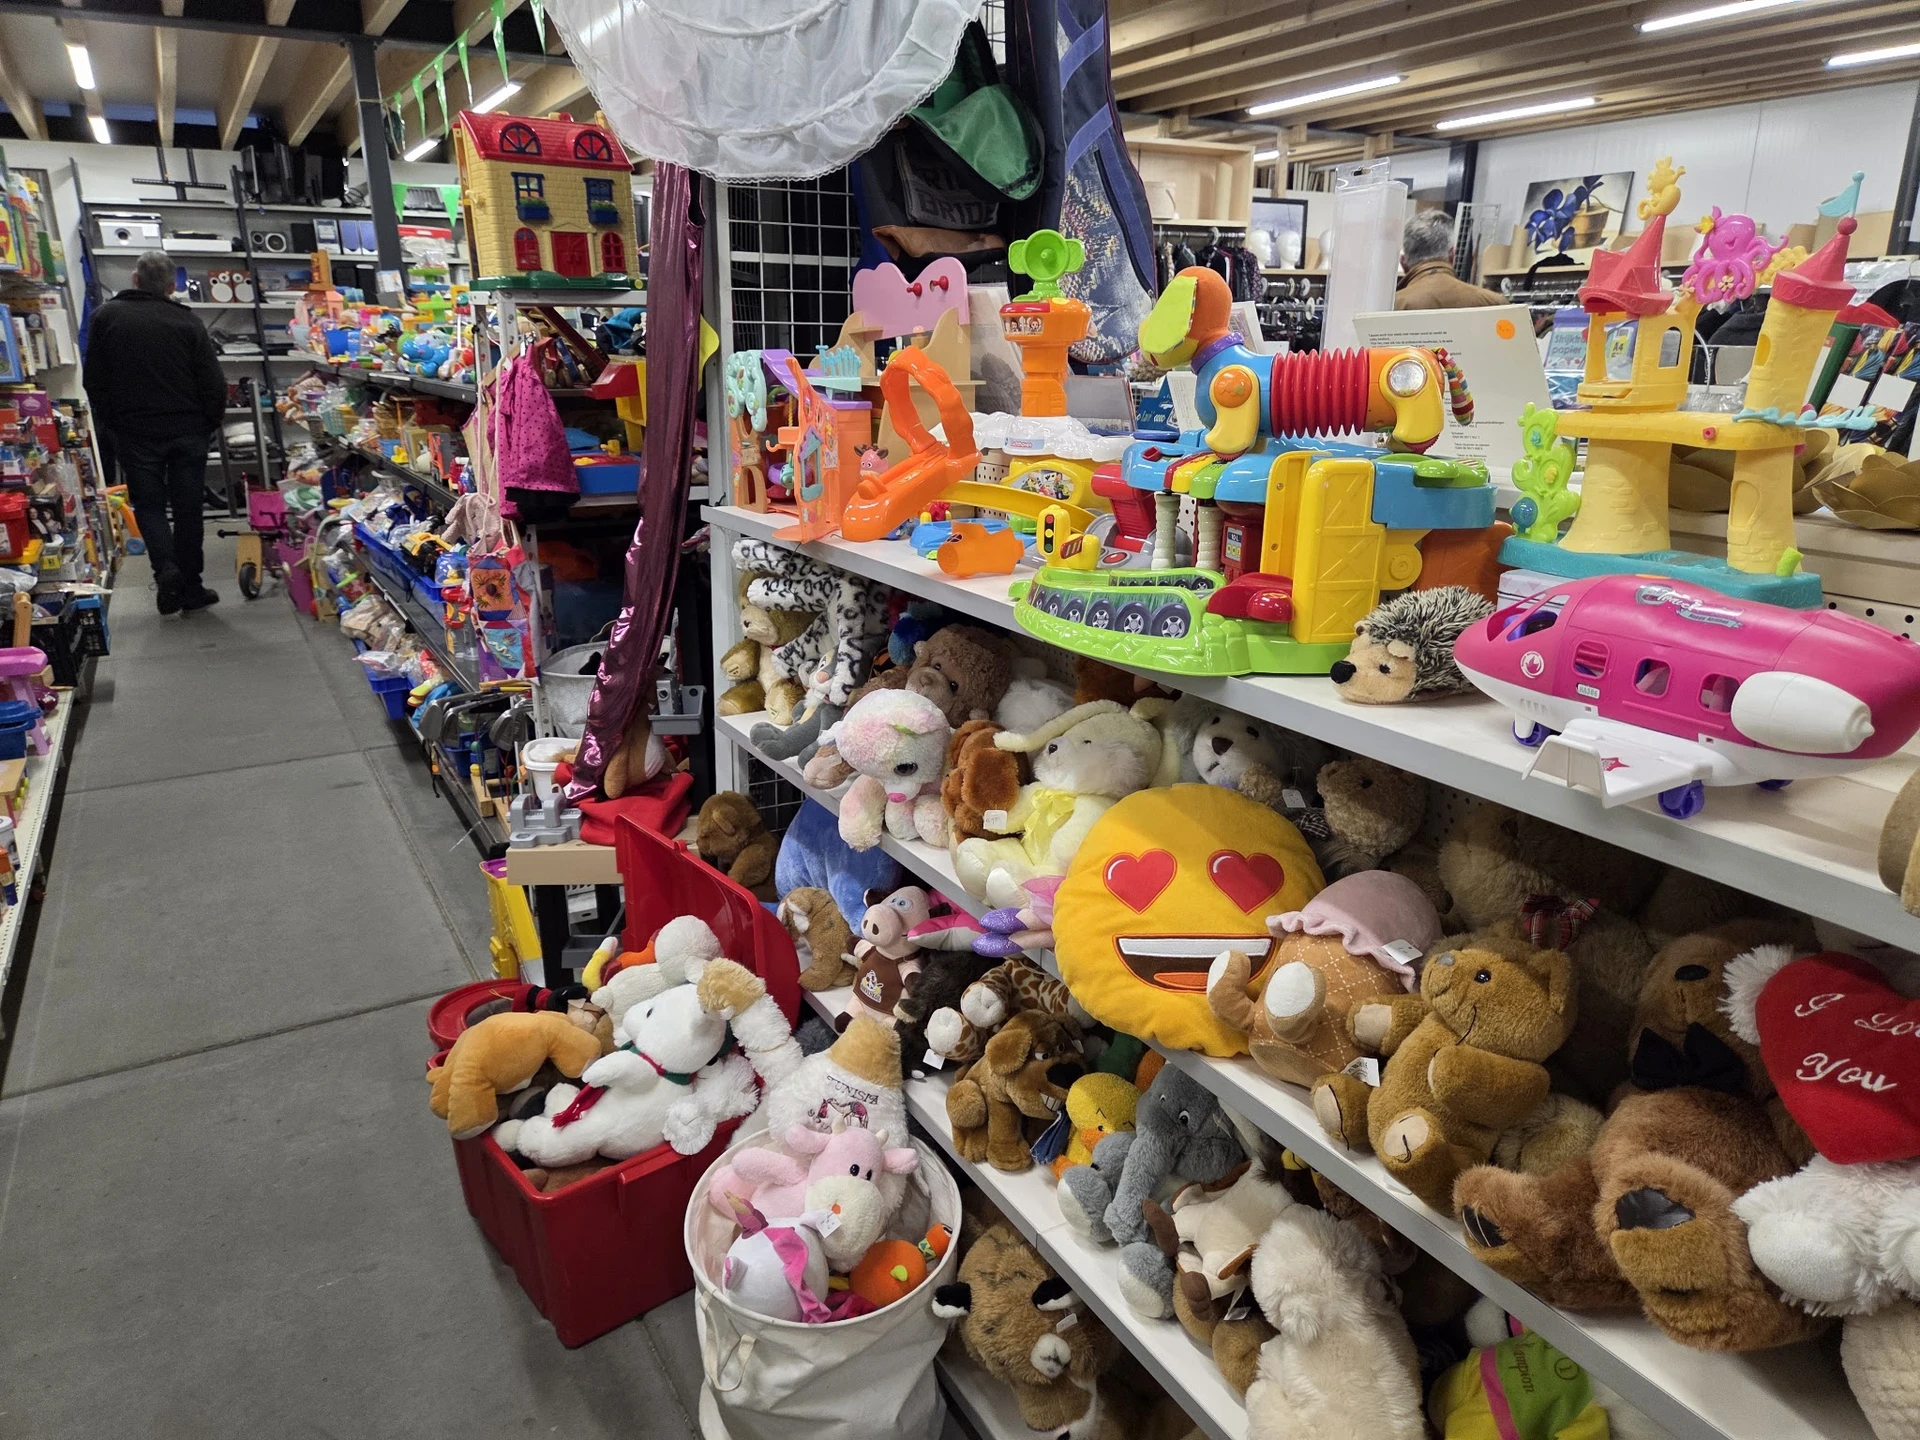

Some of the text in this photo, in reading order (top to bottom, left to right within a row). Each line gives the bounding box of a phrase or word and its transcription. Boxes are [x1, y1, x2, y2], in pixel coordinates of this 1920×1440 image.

[1551, 345, 1582, 356] papier
[1794, 993, 1845, 1017] I
[1795, 1052, 1898, 1092] You
[826, 1075, 879, 1105] TUNISIA
